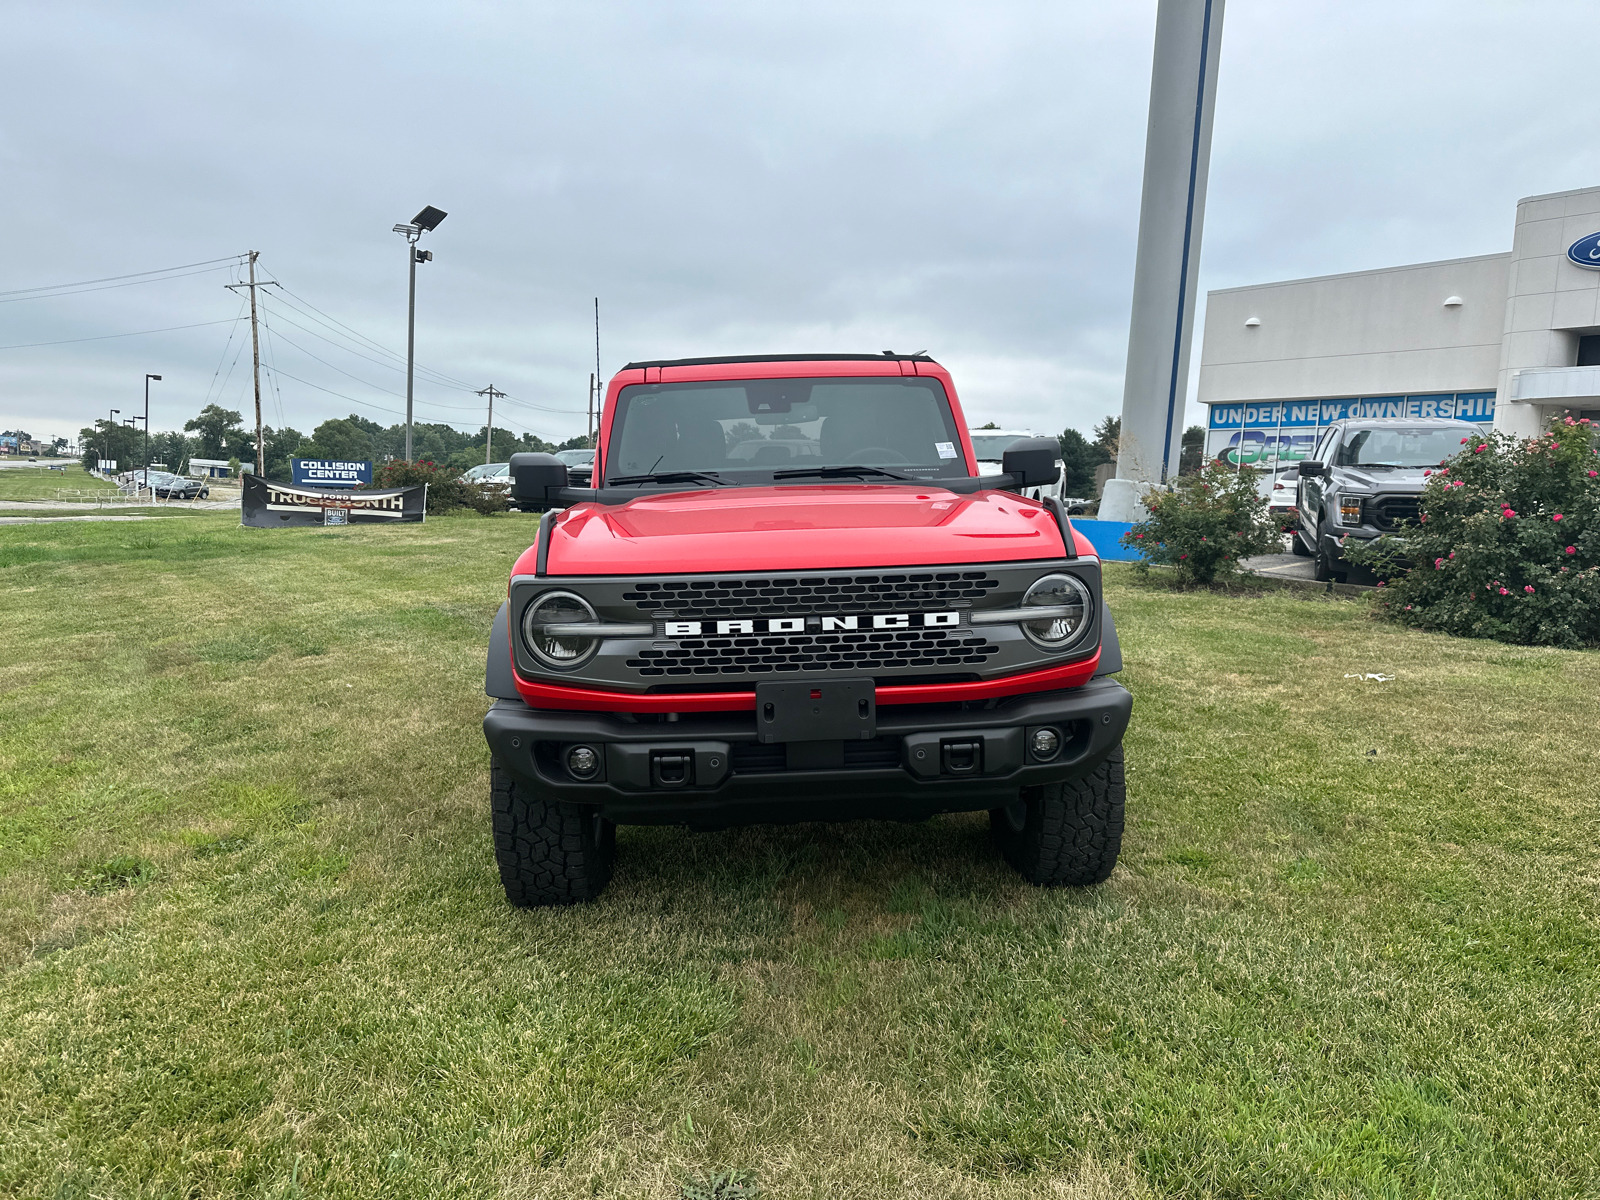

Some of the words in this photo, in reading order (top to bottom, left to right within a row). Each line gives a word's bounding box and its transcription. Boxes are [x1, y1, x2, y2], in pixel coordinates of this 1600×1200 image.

[1214, 407, 1287, 424] UNDER
[1291, 404, 1342, 421] NEW
[300, 461, 365, 471] COLLISION
[308, 470, 357, 479] CENTER
[327, 509, 345, 517] BUILT
[665, 612, 960, 636] BRONCO
